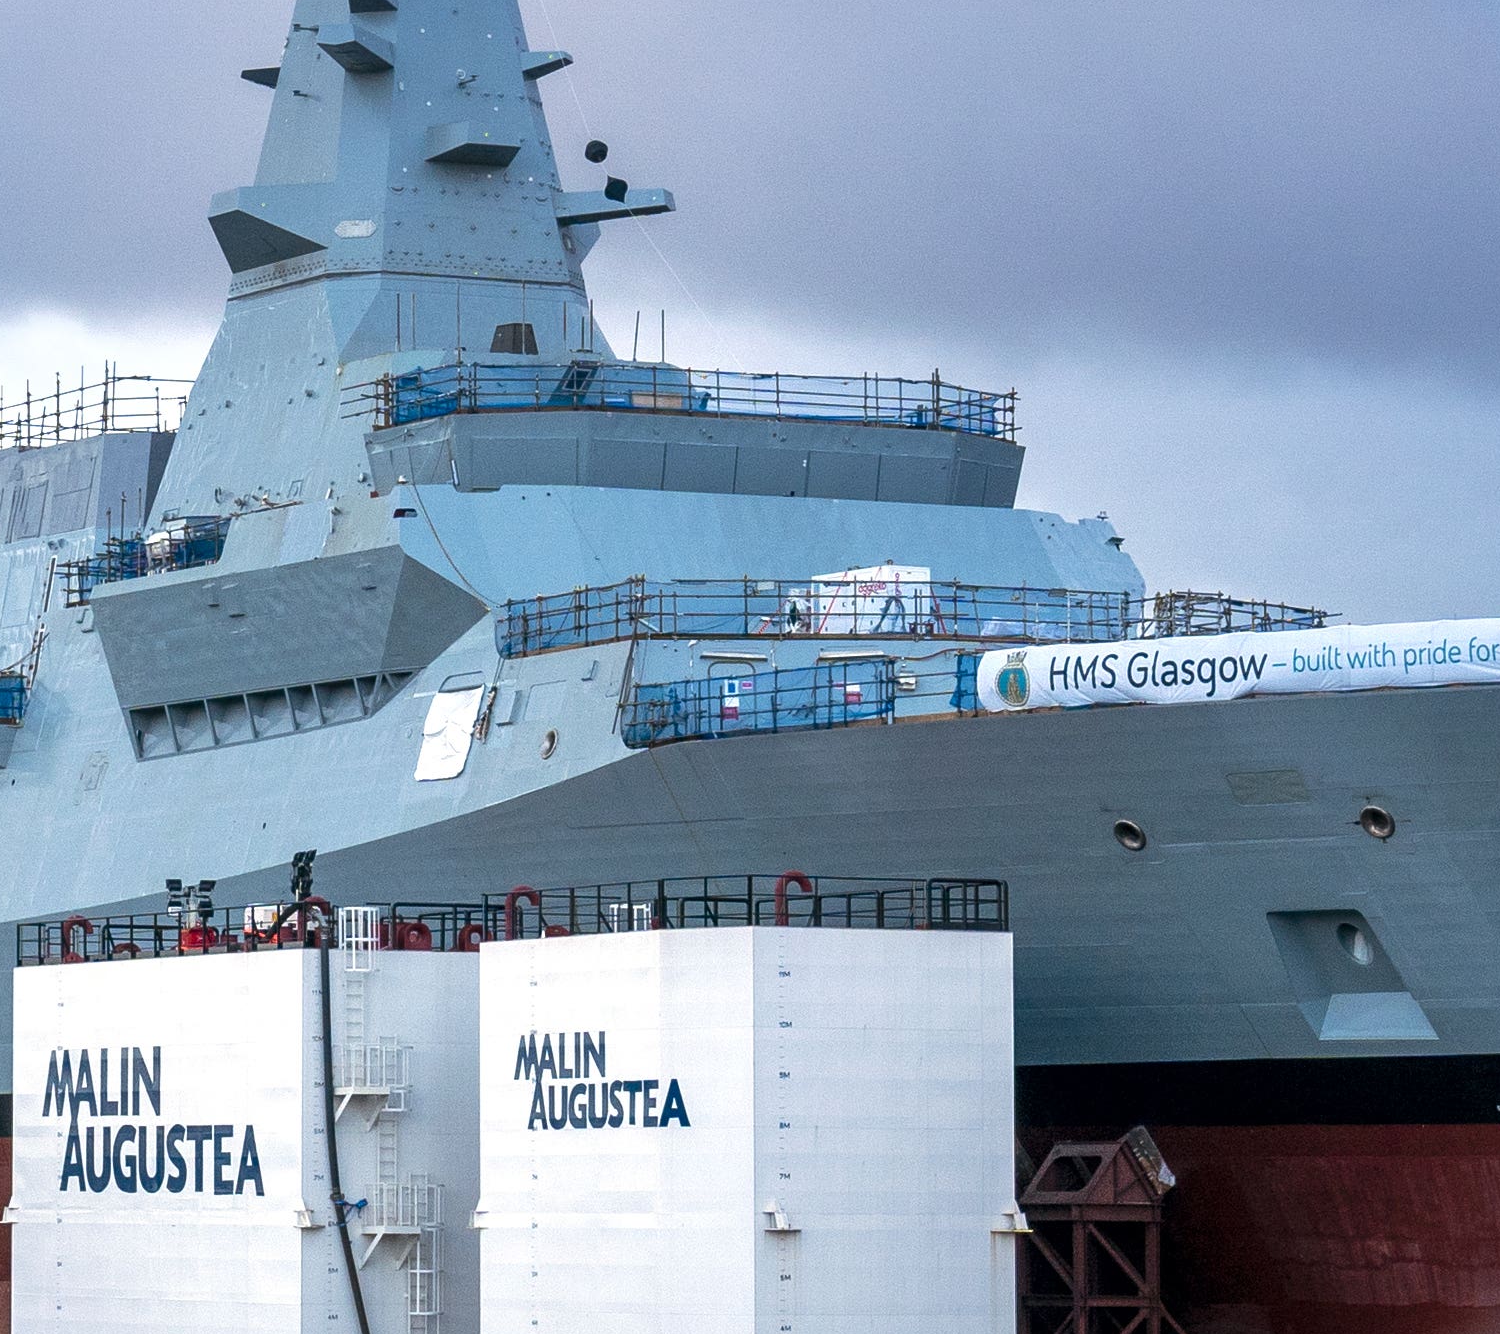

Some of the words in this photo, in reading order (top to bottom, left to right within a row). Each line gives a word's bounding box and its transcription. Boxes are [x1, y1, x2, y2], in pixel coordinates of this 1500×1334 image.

[1049, 653, 1119, 691] HMS
[1126, 650, 1268, 697] Glasgow
[1292, 645, 1343, 673] built
[1346, 641, 1396, 669] with
[1403, 639, 1461, 674] pride
[1468, 636, 1500, 662] for
[42, 1046, 161, 1117] MALIN
[514, 1031, 605, 1080] MALIN
[528, 1078, 691, 1130] AUGUSTEA
[59, 1124, 265, 1196] AUGUSTEA
